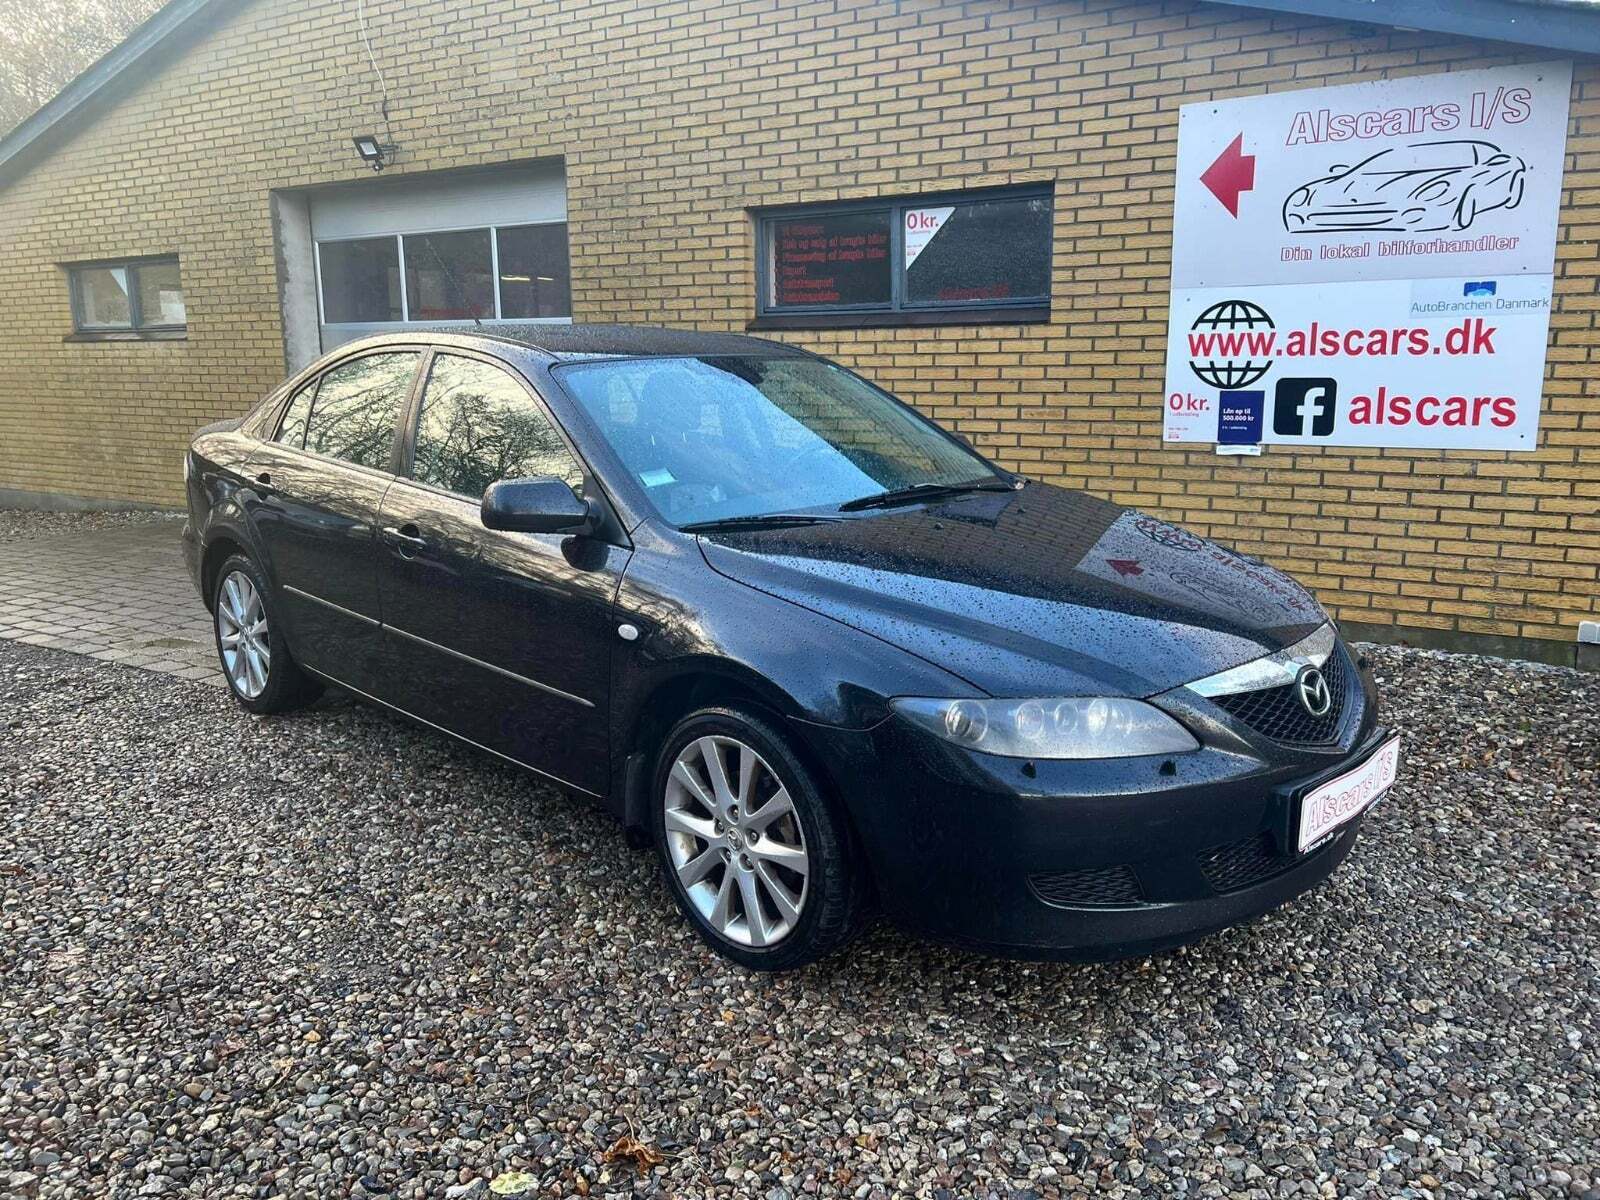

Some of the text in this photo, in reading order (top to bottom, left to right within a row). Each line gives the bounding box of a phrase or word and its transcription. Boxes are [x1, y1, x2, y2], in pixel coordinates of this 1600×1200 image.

[1286, 103, 1460, 146] Alscars
[920, 212, 938, 228] kr.
[1280, 235, 1520, 262] Din lokal bilforhandler
[1411, 297, 1549, 313] AutoBranchen Danmark
[1187, 318, 1497, 358] www.alscars.dk
[1187, 393, 1210, 411] kr.
[1348, 387, 1517, 428] alscars
[1306, 772, 1374, 837] Alscars
